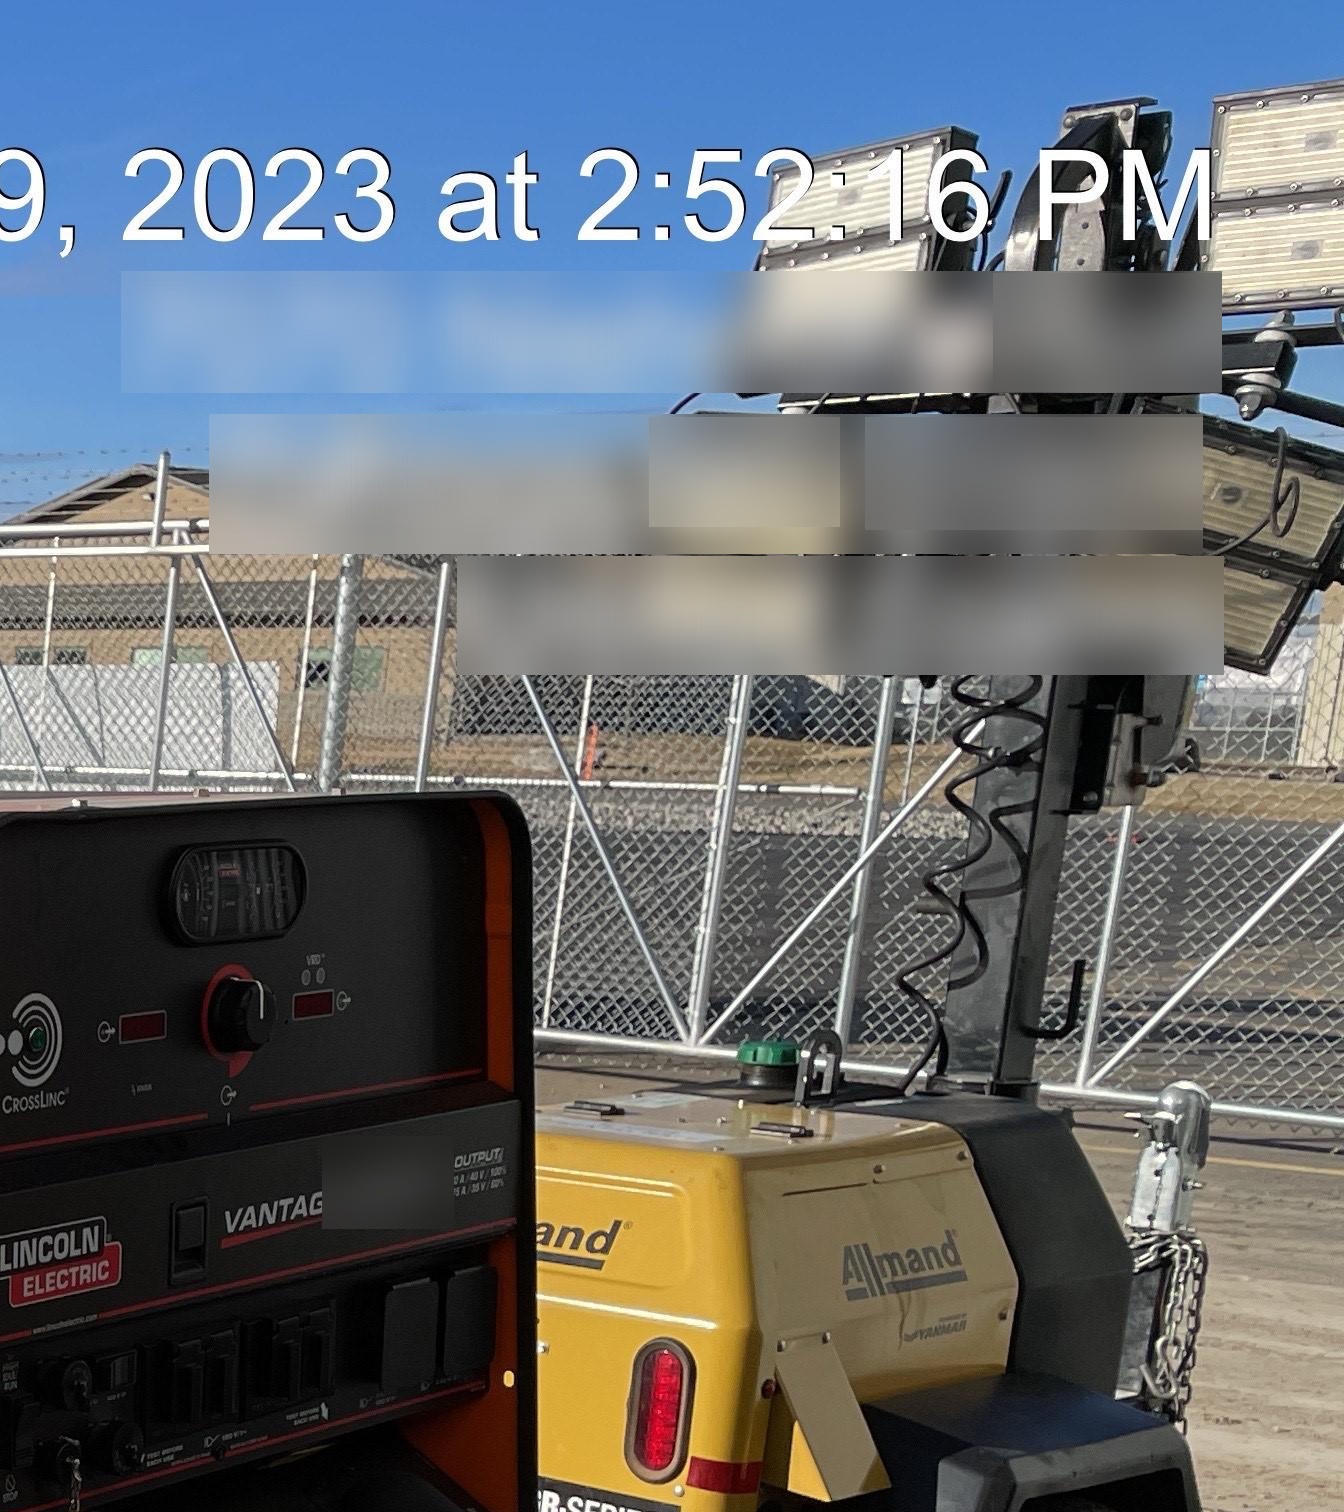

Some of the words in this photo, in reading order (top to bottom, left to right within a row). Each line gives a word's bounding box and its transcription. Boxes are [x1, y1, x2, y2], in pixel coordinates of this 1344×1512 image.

[454, 1146, 502, 1169] OUTPUT
[0, 1224, 100, 1273] LINCOLN
[842, 1228, 964, 1297] Allmand
[22, 1259, 110, 1298] ELECTRIC
[919, 1319, 968, 1341] YANMAR
